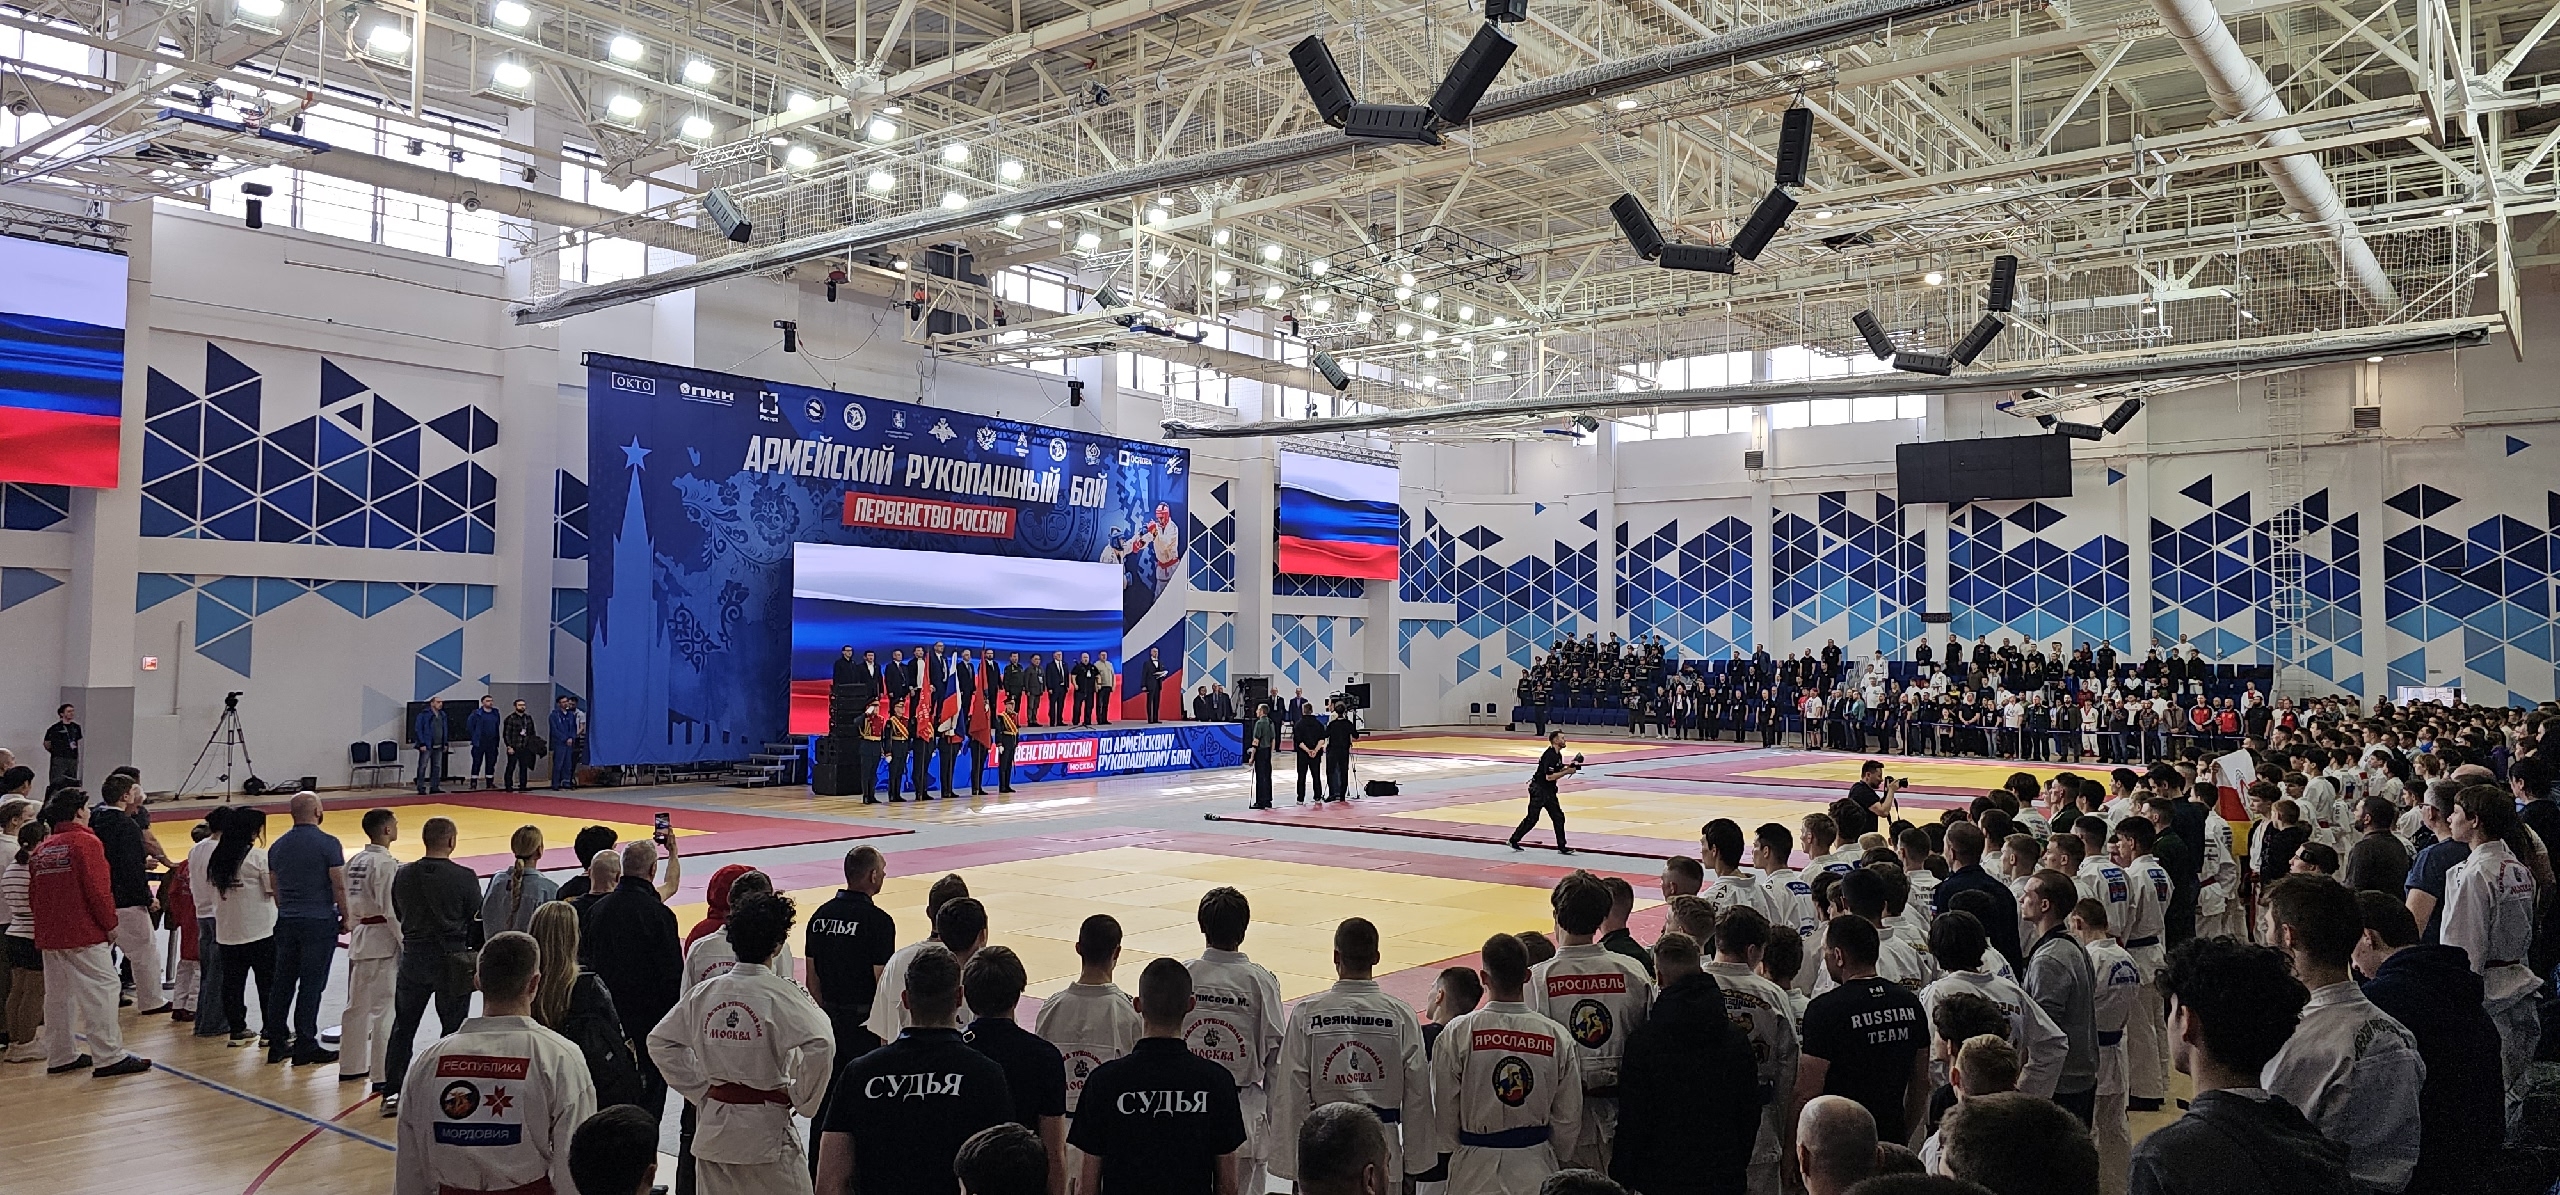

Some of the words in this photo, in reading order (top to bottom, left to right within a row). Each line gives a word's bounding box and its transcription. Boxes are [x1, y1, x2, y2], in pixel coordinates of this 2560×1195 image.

[616, 376, 651, 391] ОКТО
[692, 386, 734, 400] ПМН
[742, 434, 895, 486] АРМЕЙСКИЙ
[904, 453, 1062, 504] РУКОПАШНЫЙ
[1069, 472, 1108, 509] БОЙ
[854, 497, 952, 530] ПЕРВЕНСТВО
[952, 507, 1008, 534] РОССИИ
[1056, 740, 1093, 760] РОССИИ
[1099, 737, 1113, 755] ПО
[1113, 731, 1176, 754] АРМЕЙСКОМУ
[1069, 762, 1095, 771] МОСКВА
[1097, 749, 1171, 772] РУКОПАШНОМУ
[1170, 748, 1192, 766] БОЮ
[812, 918, 860, 937] СУДЬЯ
[1548, 977, 1626, 993] ЯРОСЛАВЛЬ
[1310, 1014, 1394, 1029] Деянышев
[1851, 1007, 1916, 1029] RUSSIAN
[1475, 1033, 1553, 1051] ЯРОСЛАВЛЬ
[1867, 1027, 1909, 1044] TEAM
[441, 1060, 522, 1073] РЕСПУБЛИКА
[864, 1071, 965, 1102] СУДЬЯ
[1116, 1090, 1210, 1119] СУДЬЯ
[442, 1127, 510, 1140] МОРДОВИЯ
